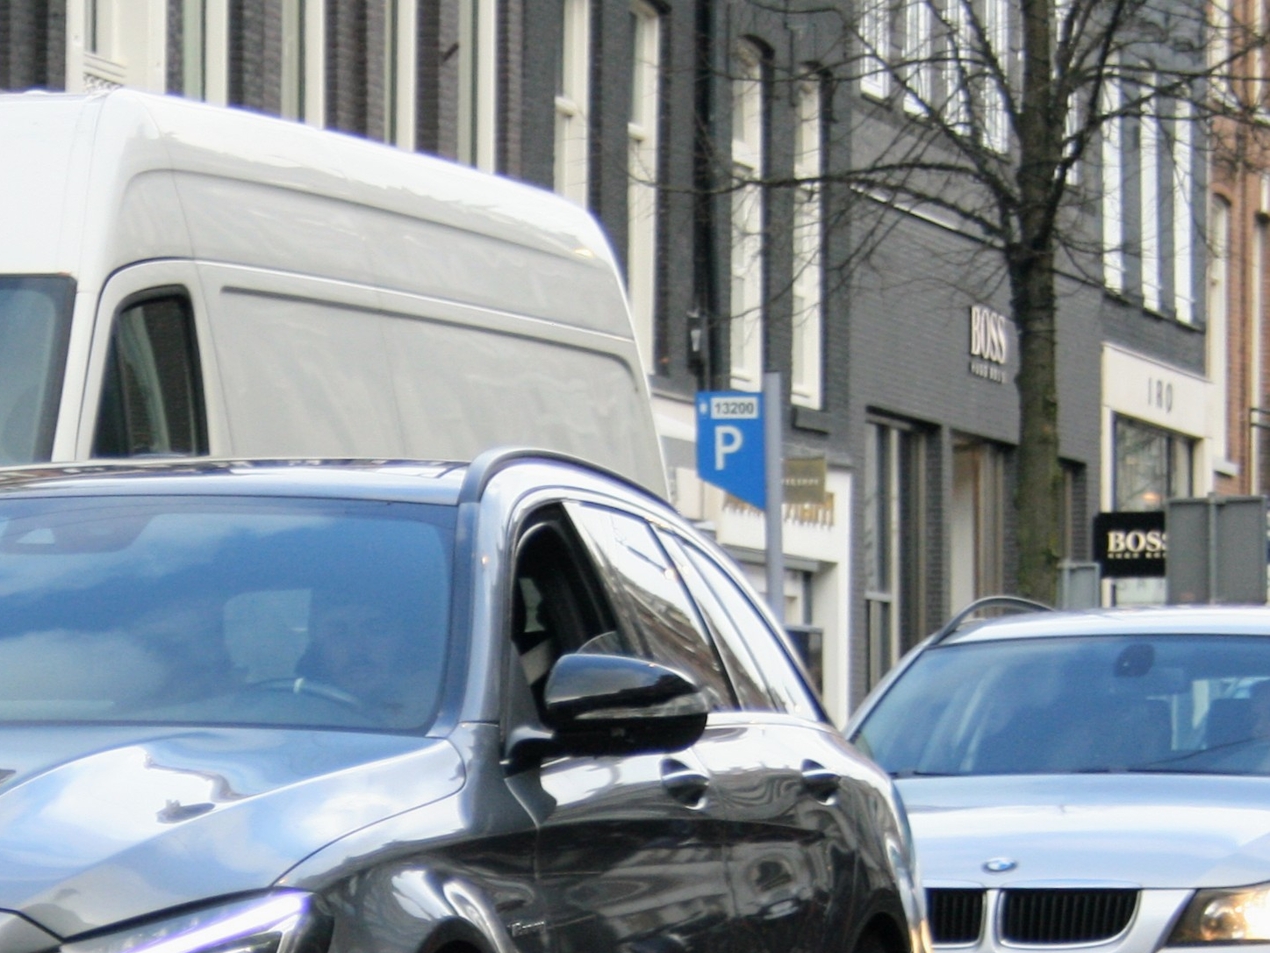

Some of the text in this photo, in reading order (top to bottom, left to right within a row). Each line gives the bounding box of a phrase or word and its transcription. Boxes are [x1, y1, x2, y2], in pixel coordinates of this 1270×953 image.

[971, 305, 1006, 364] BOSS
[714, 401, 755, 415] 13200
[714, 426, 743, 471] P
[1107, 530, 1167, 552] BOS
